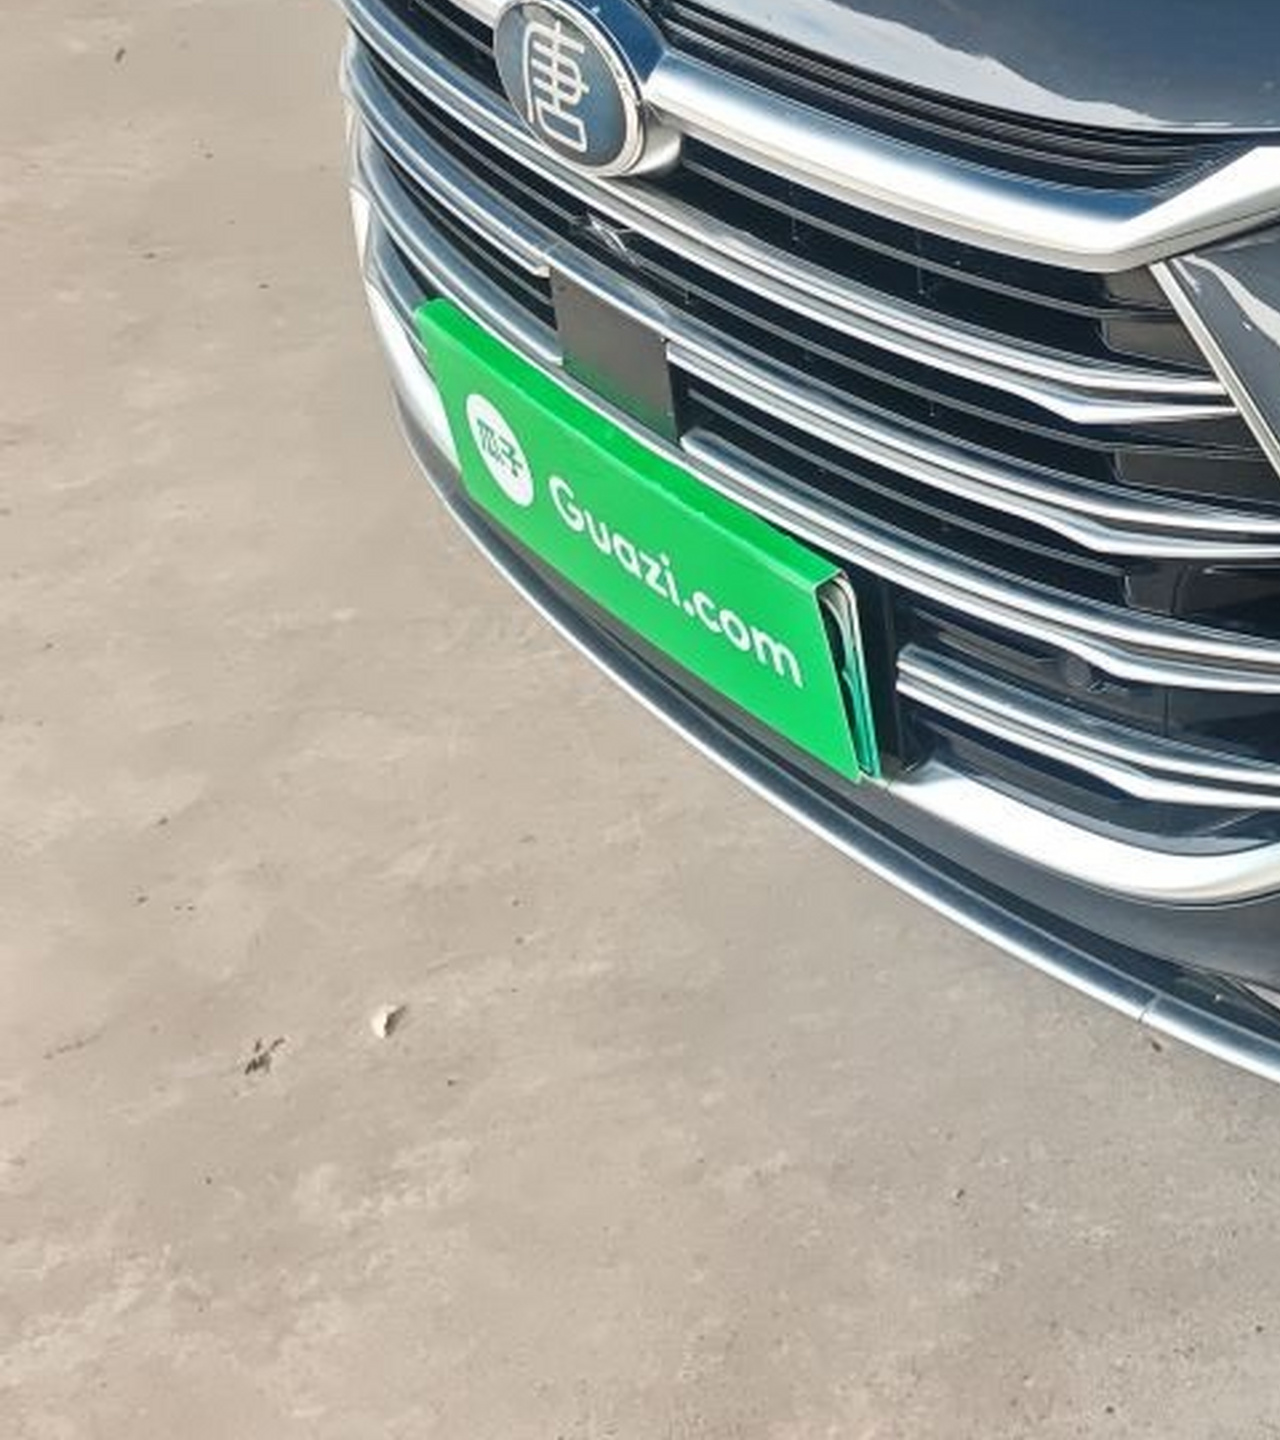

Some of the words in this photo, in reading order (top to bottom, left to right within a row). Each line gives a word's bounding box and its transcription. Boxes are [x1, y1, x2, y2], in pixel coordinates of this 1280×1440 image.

[522, 20, 589, 153] 唐
[476, 417, 524, 478] 瓜子
[548, 474, 804, 689] Guazi.com
